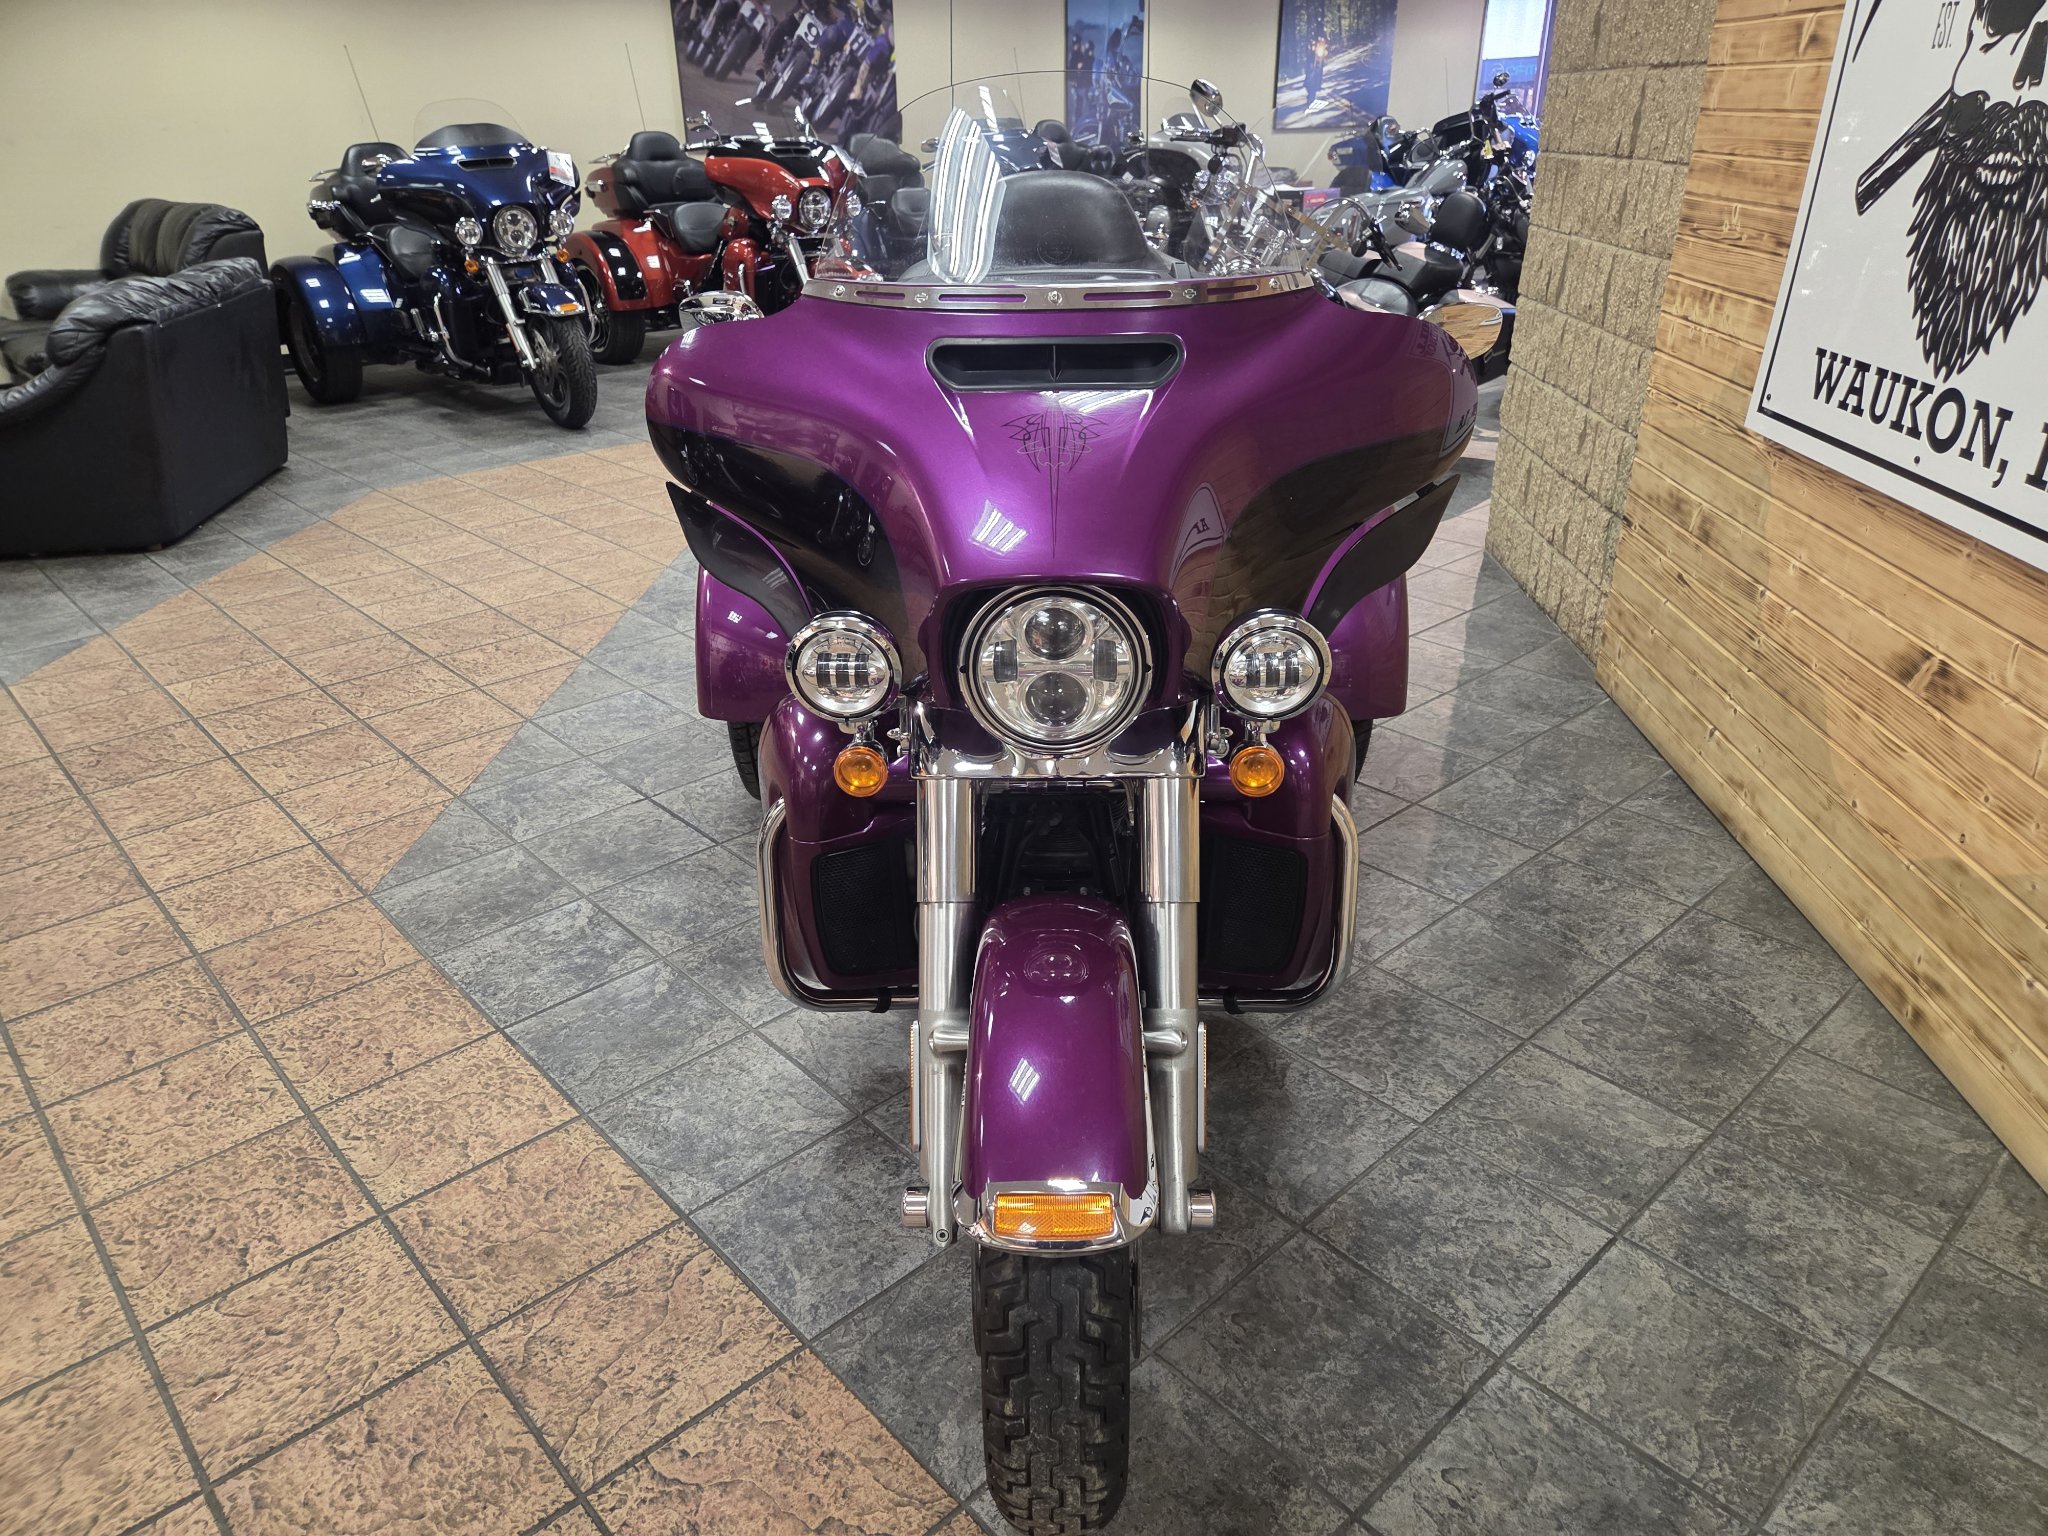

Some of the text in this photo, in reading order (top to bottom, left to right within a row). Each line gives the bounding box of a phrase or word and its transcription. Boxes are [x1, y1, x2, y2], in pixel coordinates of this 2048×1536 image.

[1931, 1, 1960, 50] EST.
[1812, 346, 2048, 493] WAUKON, I
